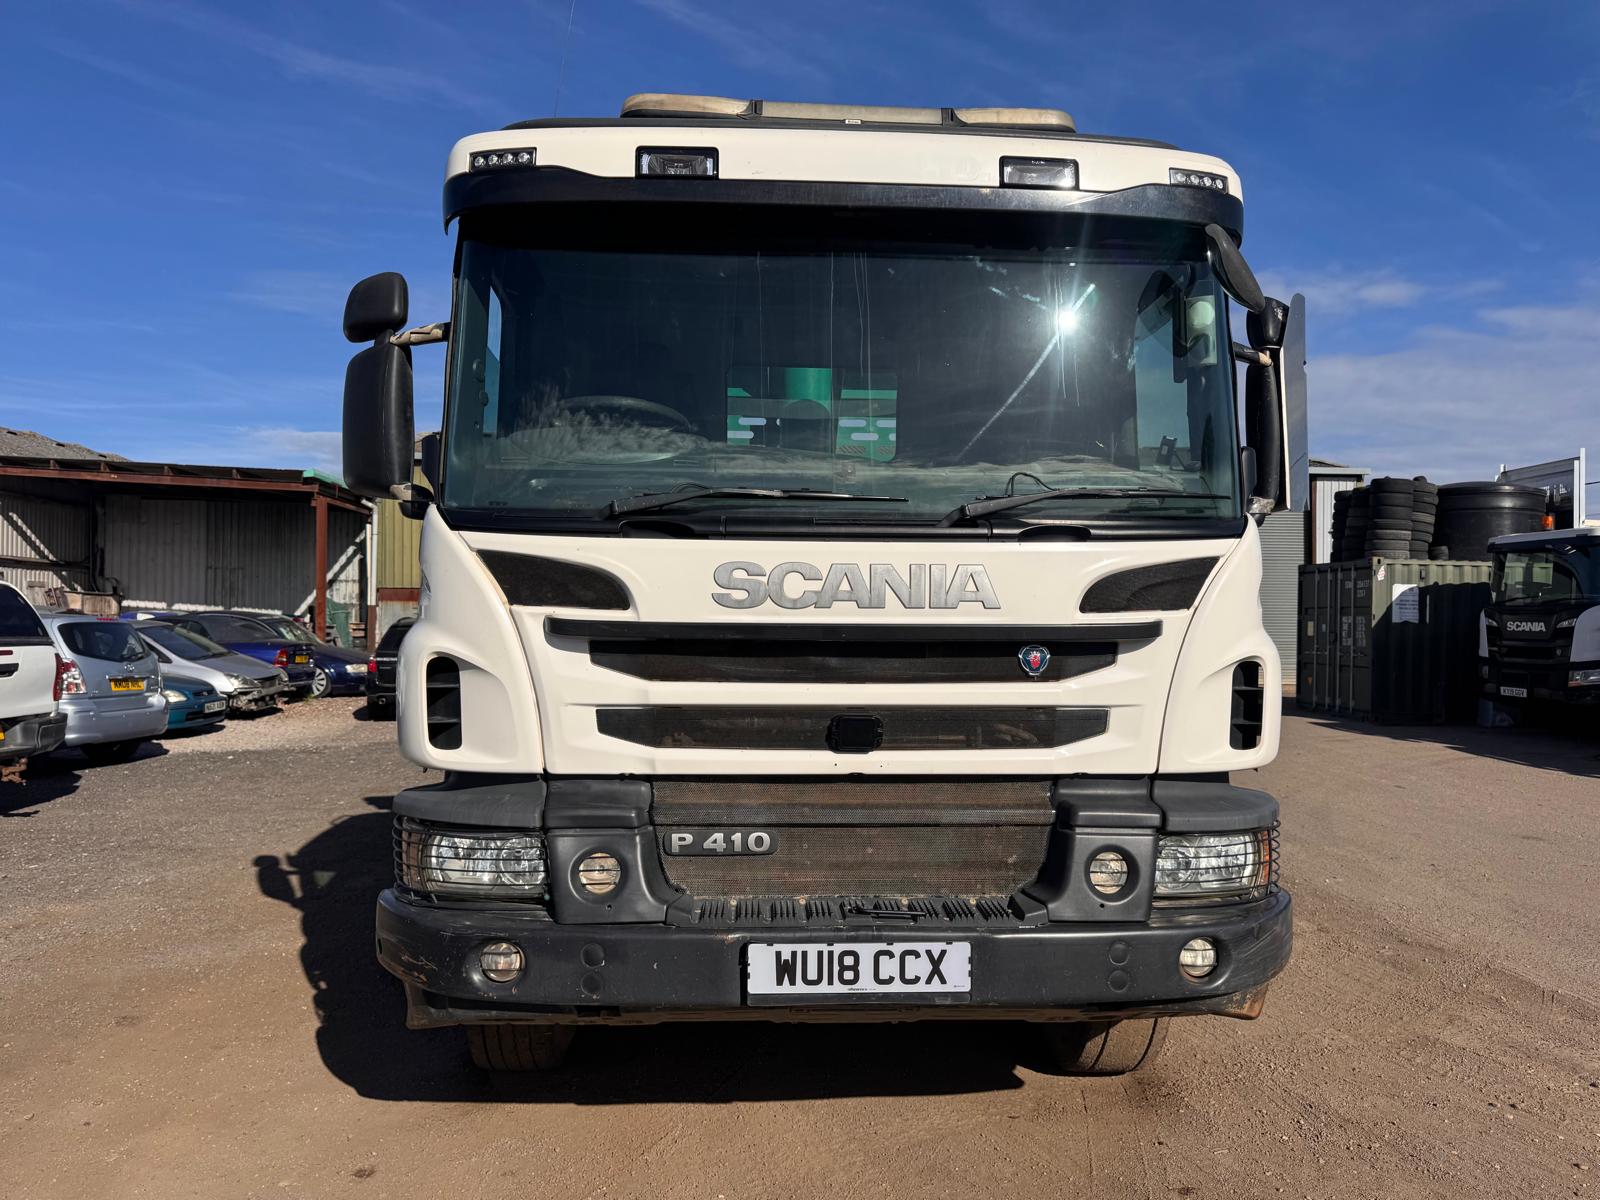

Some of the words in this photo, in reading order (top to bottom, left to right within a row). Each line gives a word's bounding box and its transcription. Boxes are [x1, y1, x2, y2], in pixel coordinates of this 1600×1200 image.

[711, 561, 1001, 610] SCANIA
[1506, 621, 1546, 632] SCANIA
[671, 833, 694, 853] P
[703, 832, 771, 853] 410
[775, 949, 860, 987] WU18
[873, 949, 947, 985] CCX
